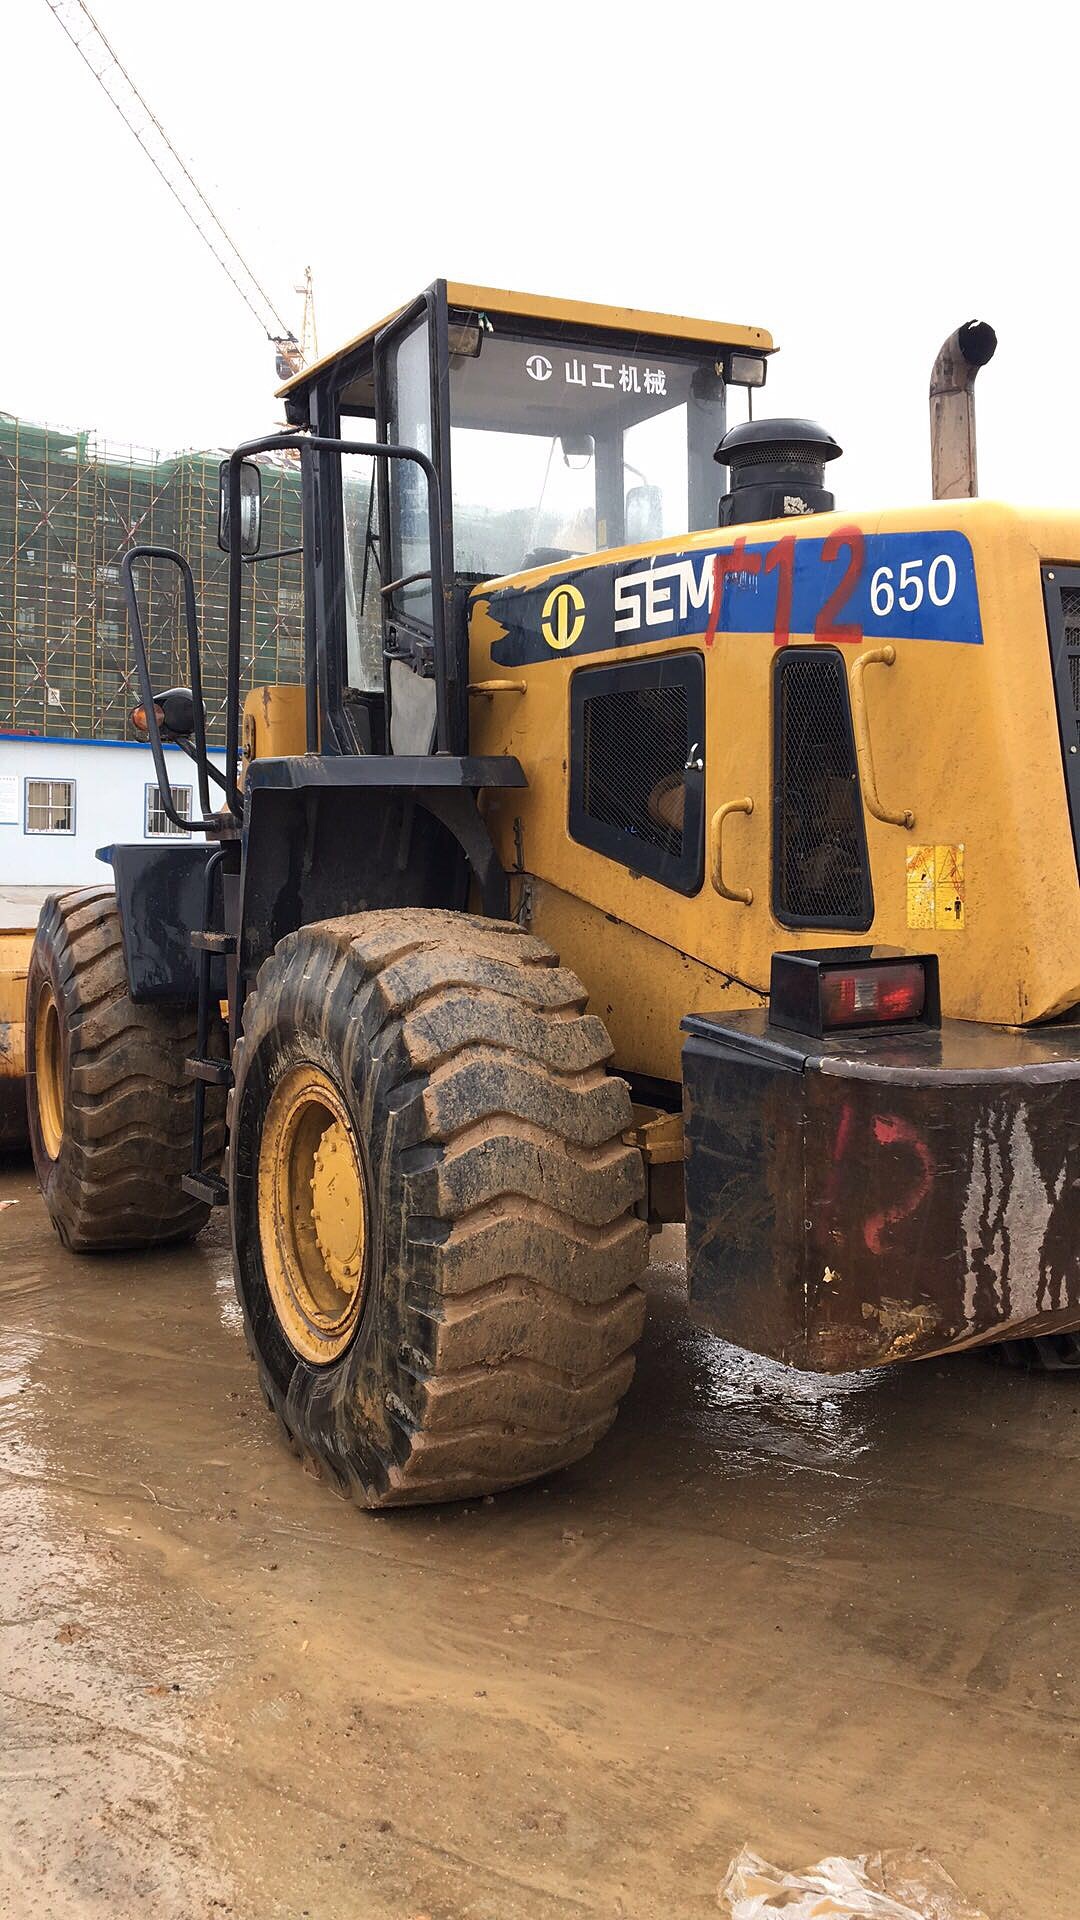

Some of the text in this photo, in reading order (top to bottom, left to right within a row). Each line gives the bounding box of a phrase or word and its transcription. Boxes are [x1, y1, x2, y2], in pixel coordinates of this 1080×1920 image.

[565, 359, 667, 396] 山工机械
[614, 553, 717, 633] SEM
[870, 554, 957, 617] 650
